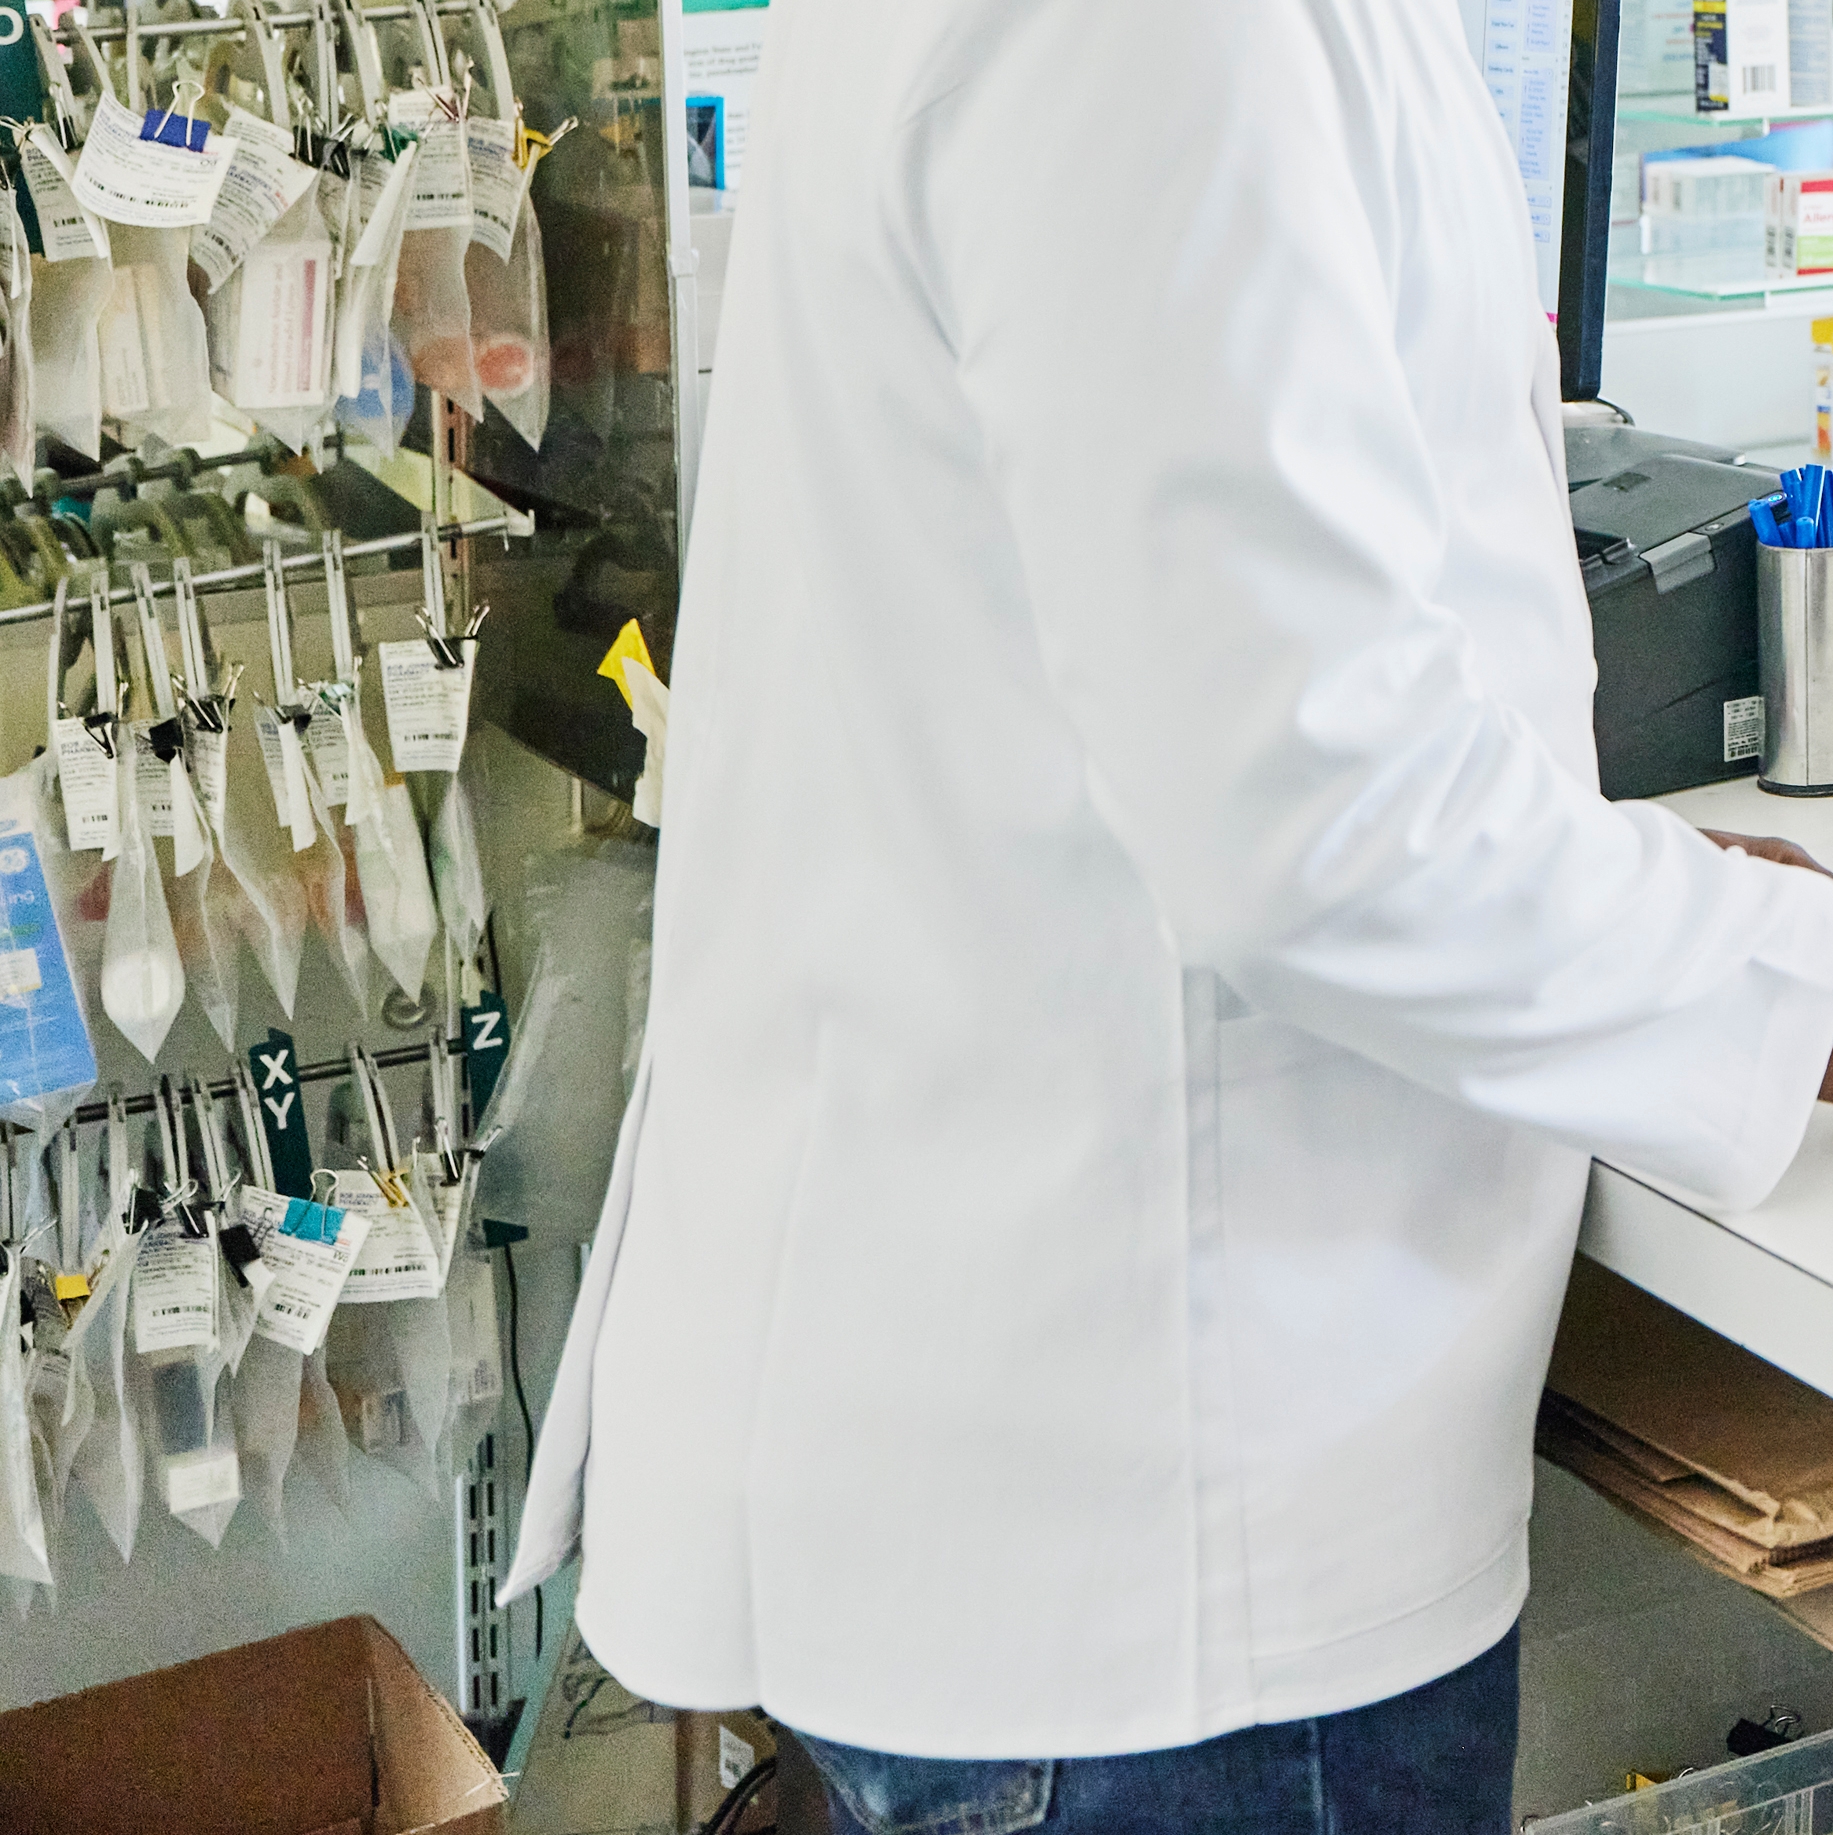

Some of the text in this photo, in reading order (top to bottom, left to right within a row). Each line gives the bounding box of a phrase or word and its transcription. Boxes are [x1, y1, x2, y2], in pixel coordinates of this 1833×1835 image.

[470, 1011, 503, 1051] Z
[259, 1048, 294, 1088] X
[263, 1092, 297, 1131] Y
